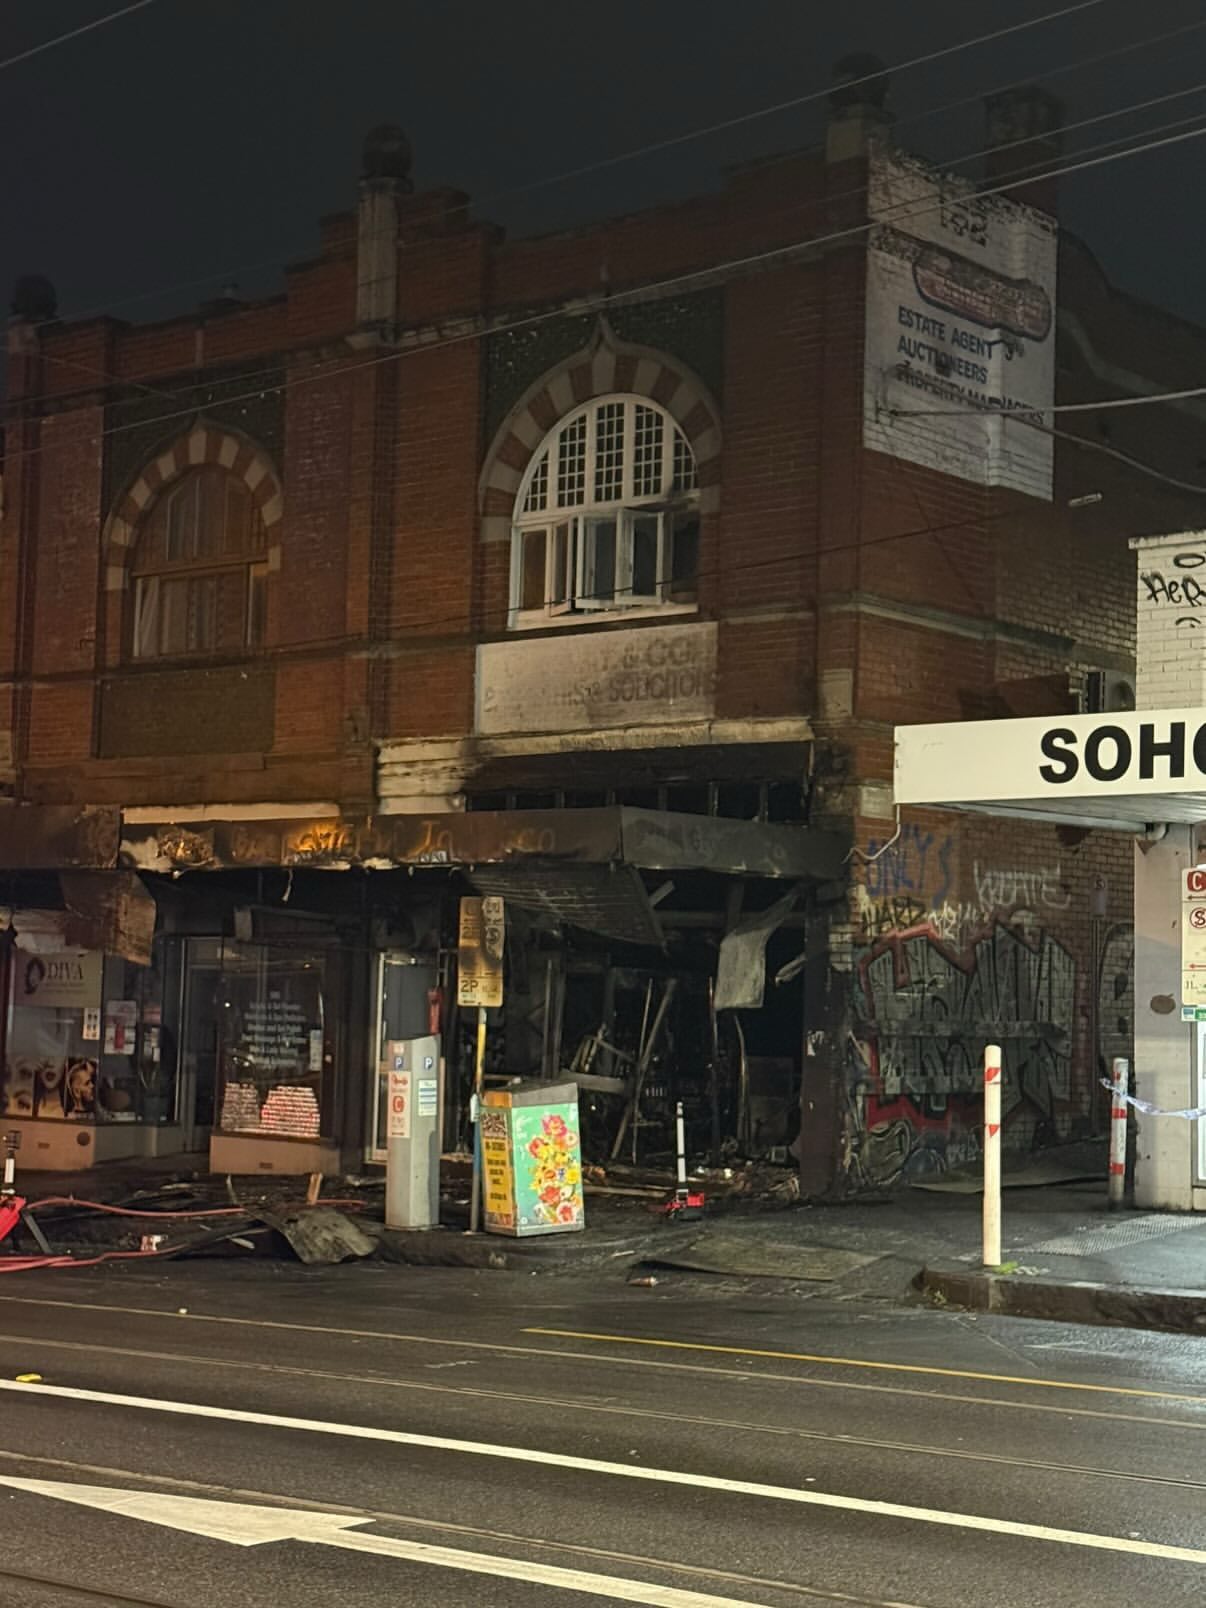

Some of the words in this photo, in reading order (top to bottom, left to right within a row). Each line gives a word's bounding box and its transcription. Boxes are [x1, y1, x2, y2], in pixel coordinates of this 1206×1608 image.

[898, 304, 946, 342] ESTATE
[47, 961, 84, 981] DIVA
[461, 979, 479, 993] 2P
